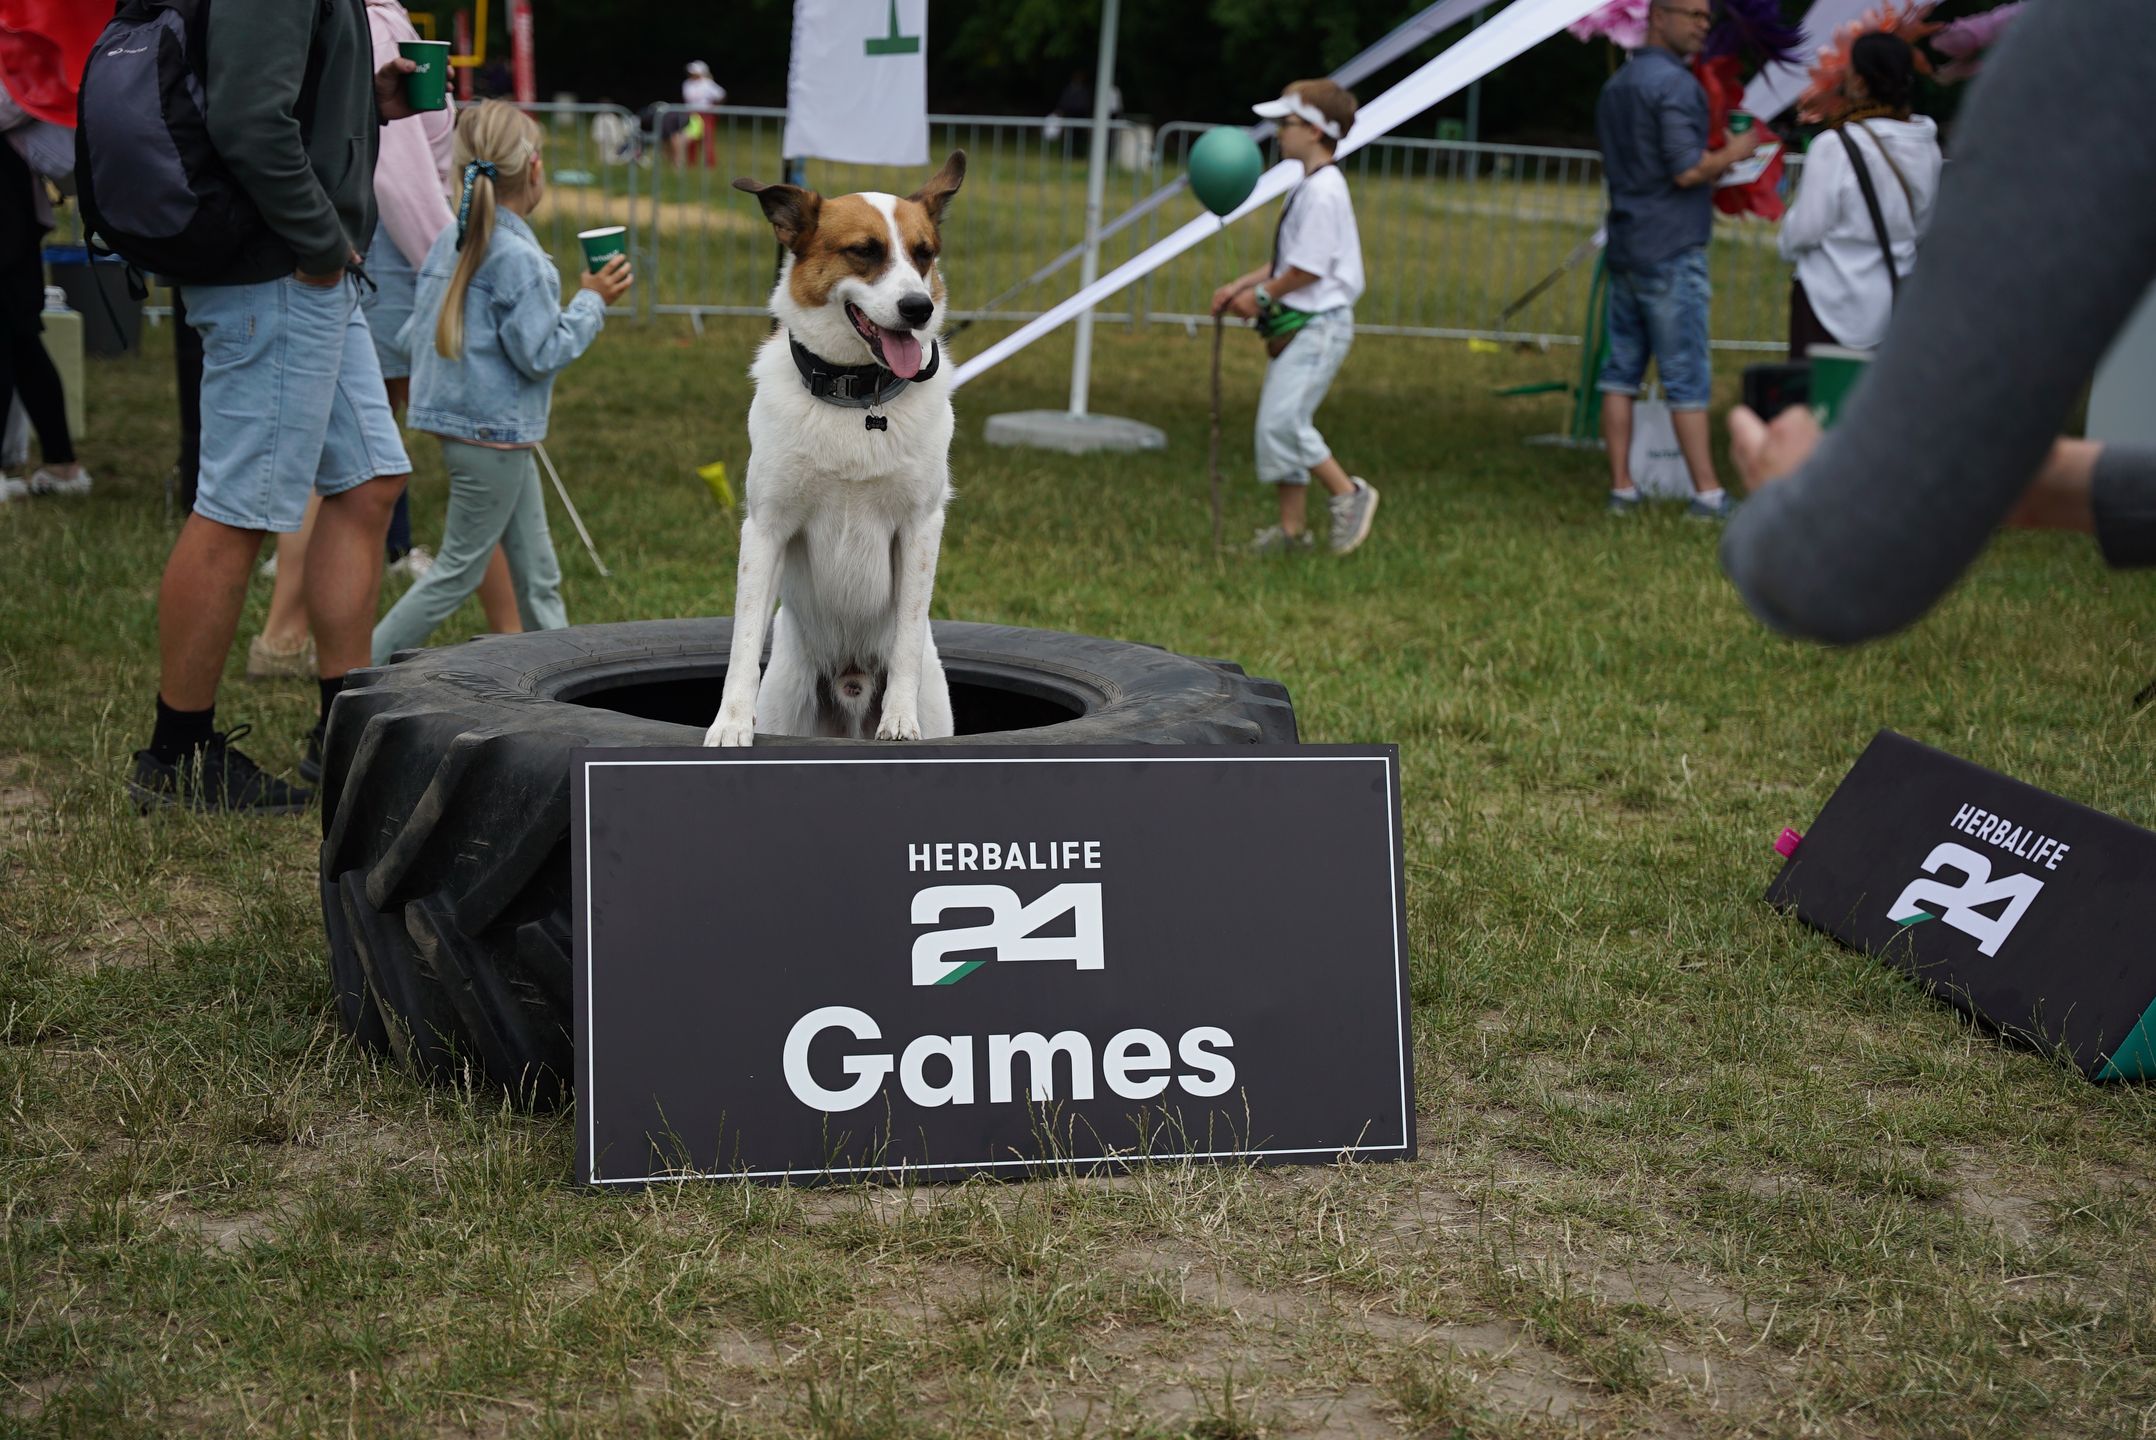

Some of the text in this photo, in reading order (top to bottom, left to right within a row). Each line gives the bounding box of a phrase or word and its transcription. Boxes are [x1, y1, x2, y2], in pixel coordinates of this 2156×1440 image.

[909, 841, 1102, 871] HERBALIFE
[1950, 803, 2070, 871] HERBALIFE
[911, 882, 1105, 985] 24
[1886, 842, 2045, 957] 24
[783, 1006, 1236, 1112] Games
